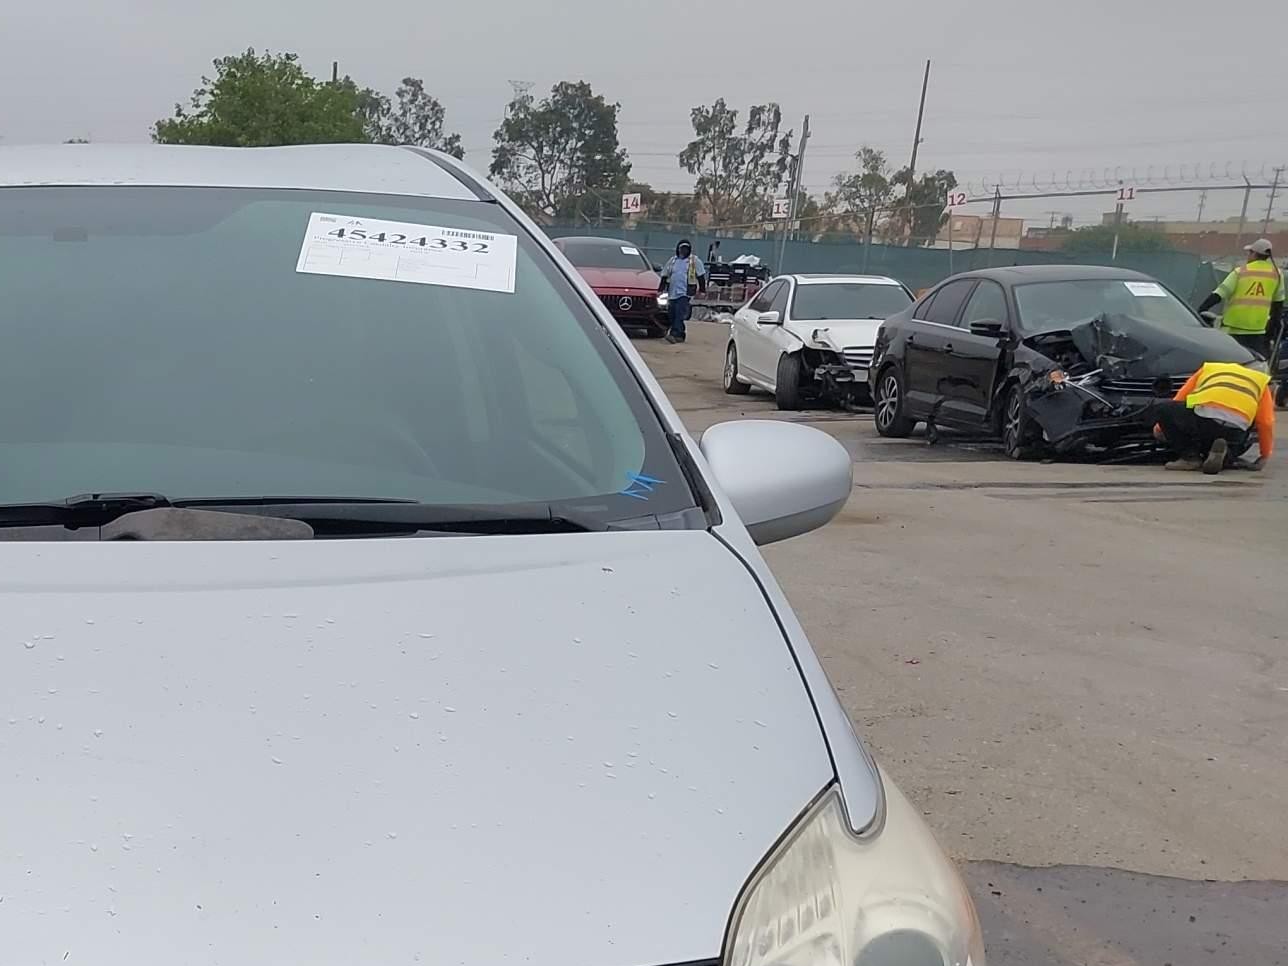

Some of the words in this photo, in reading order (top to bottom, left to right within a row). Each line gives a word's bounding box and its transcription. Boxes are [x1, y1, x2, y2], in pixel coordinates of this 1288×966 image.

[949, 193, 966, 206] 12
[1117, 188, 1135, 201] 11
[623, 197, 639, 210] 14
[774, 201, 790, 213] 13
[327, 227, 489, 254] 45424332
